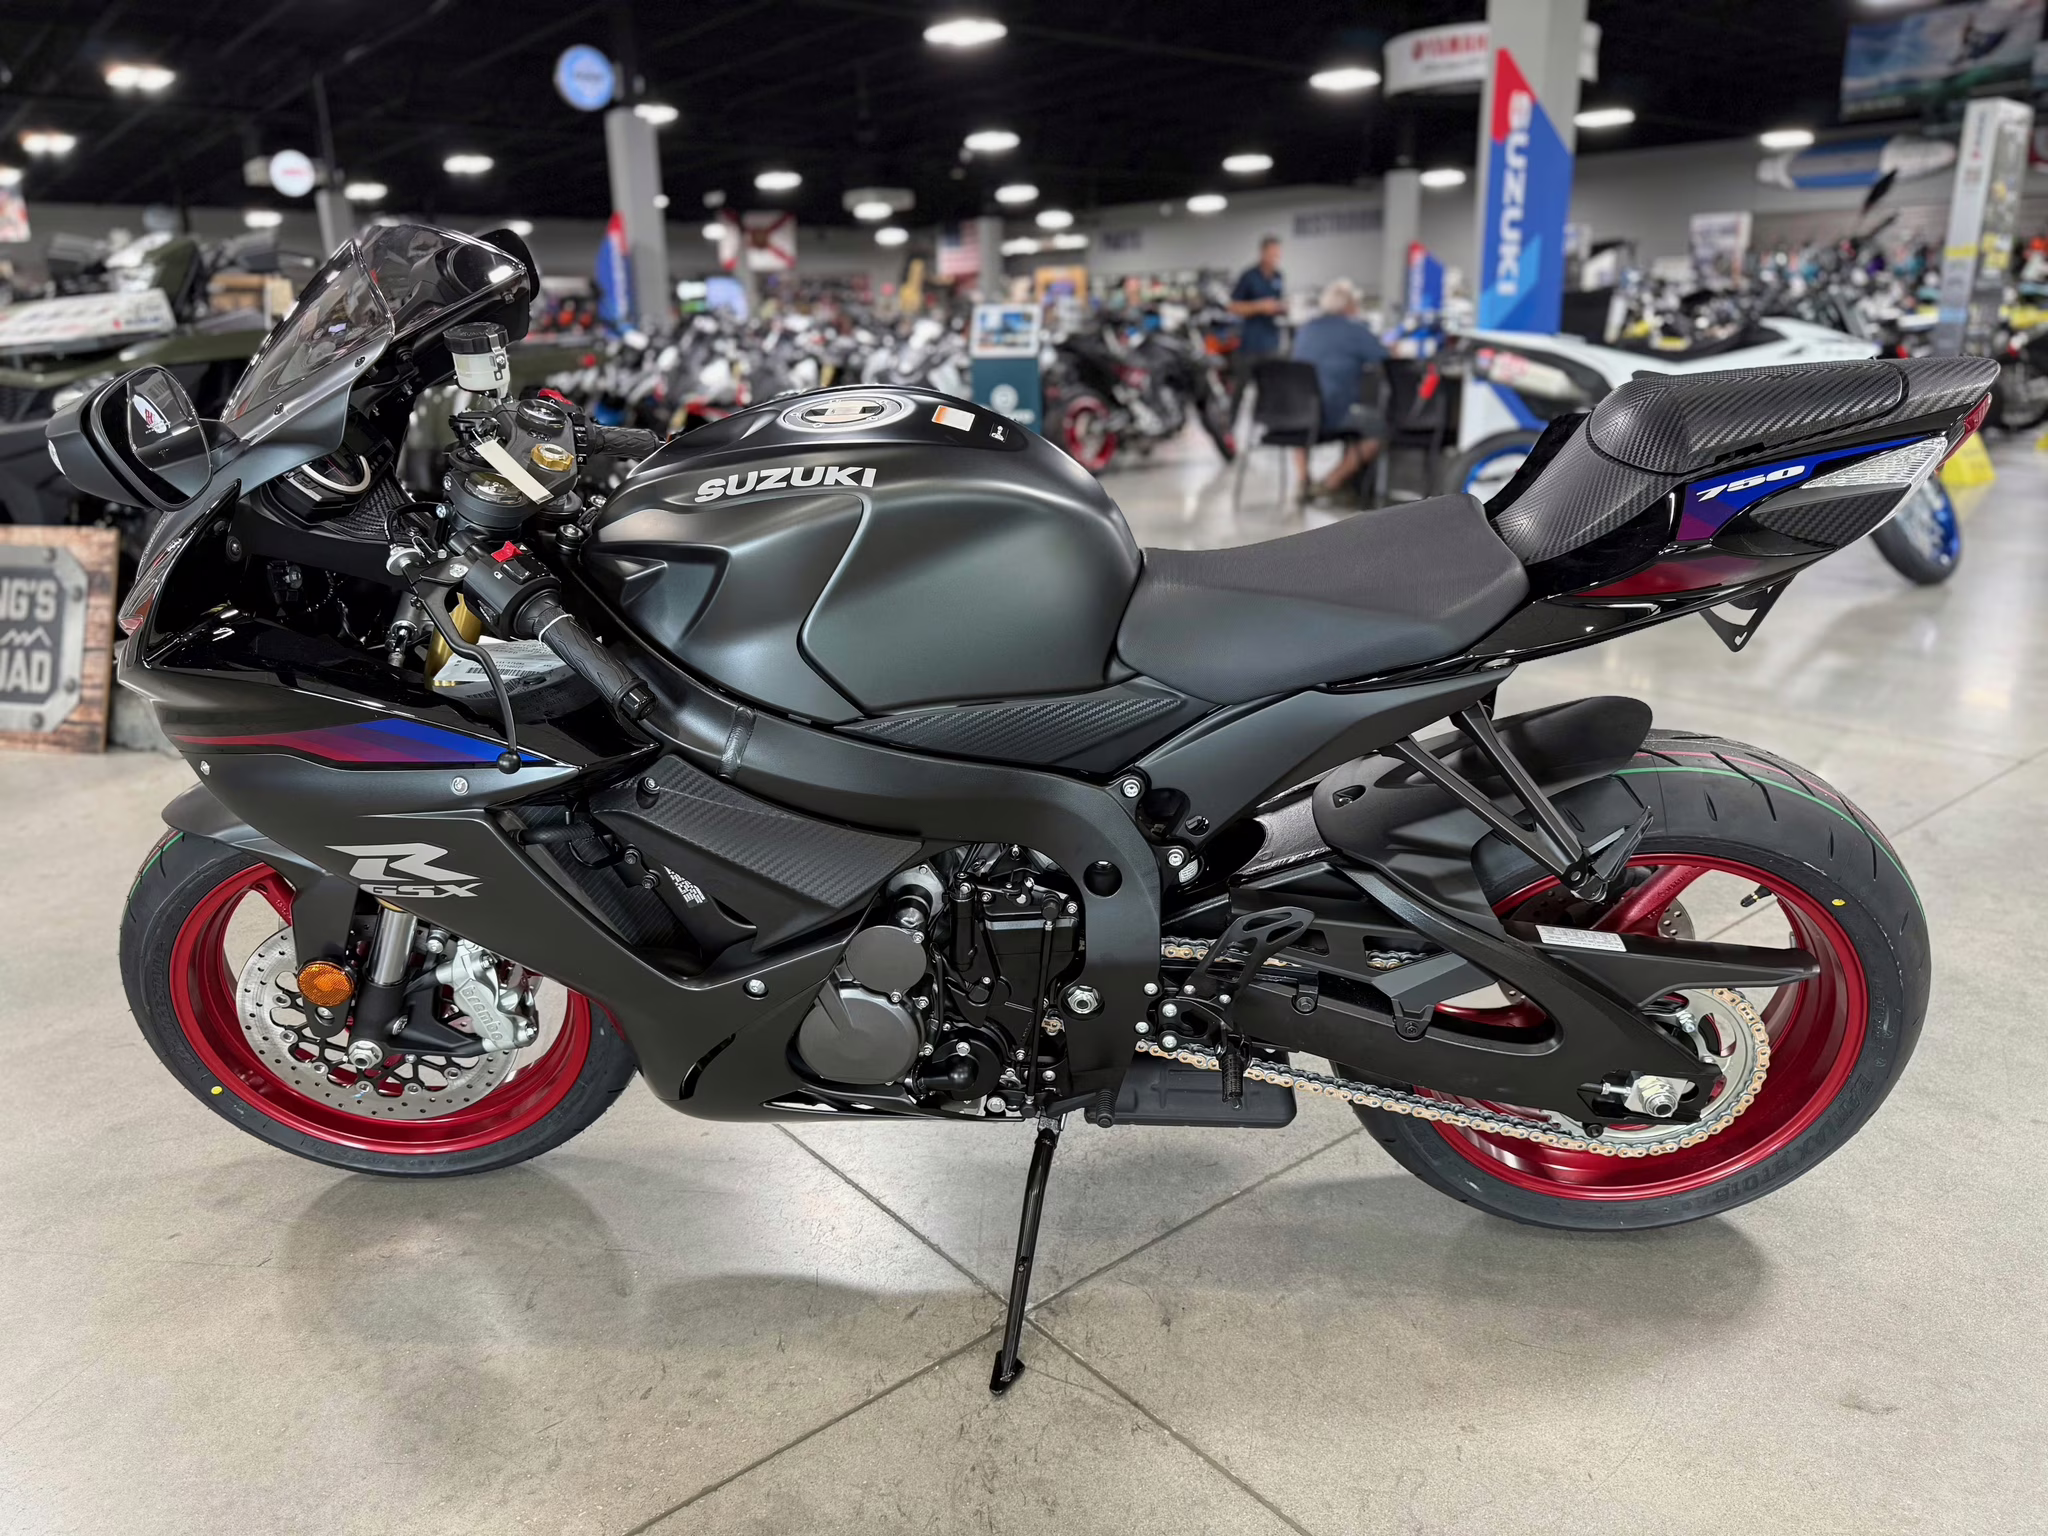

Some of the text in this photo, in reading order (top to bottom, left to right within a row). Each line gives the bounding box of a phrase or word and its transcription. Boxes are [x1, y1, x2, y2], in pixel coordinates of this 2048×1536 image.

[1496, 88, 1532, 297] SUZUKI
[694, 466, 877, 503] SUZUKI
[1696, 465, 1806, 502] 750
[325, 842, 481, 882] R
[360, 883, 484, 898] GSX
[460, 985, 504, 1041] brembo
